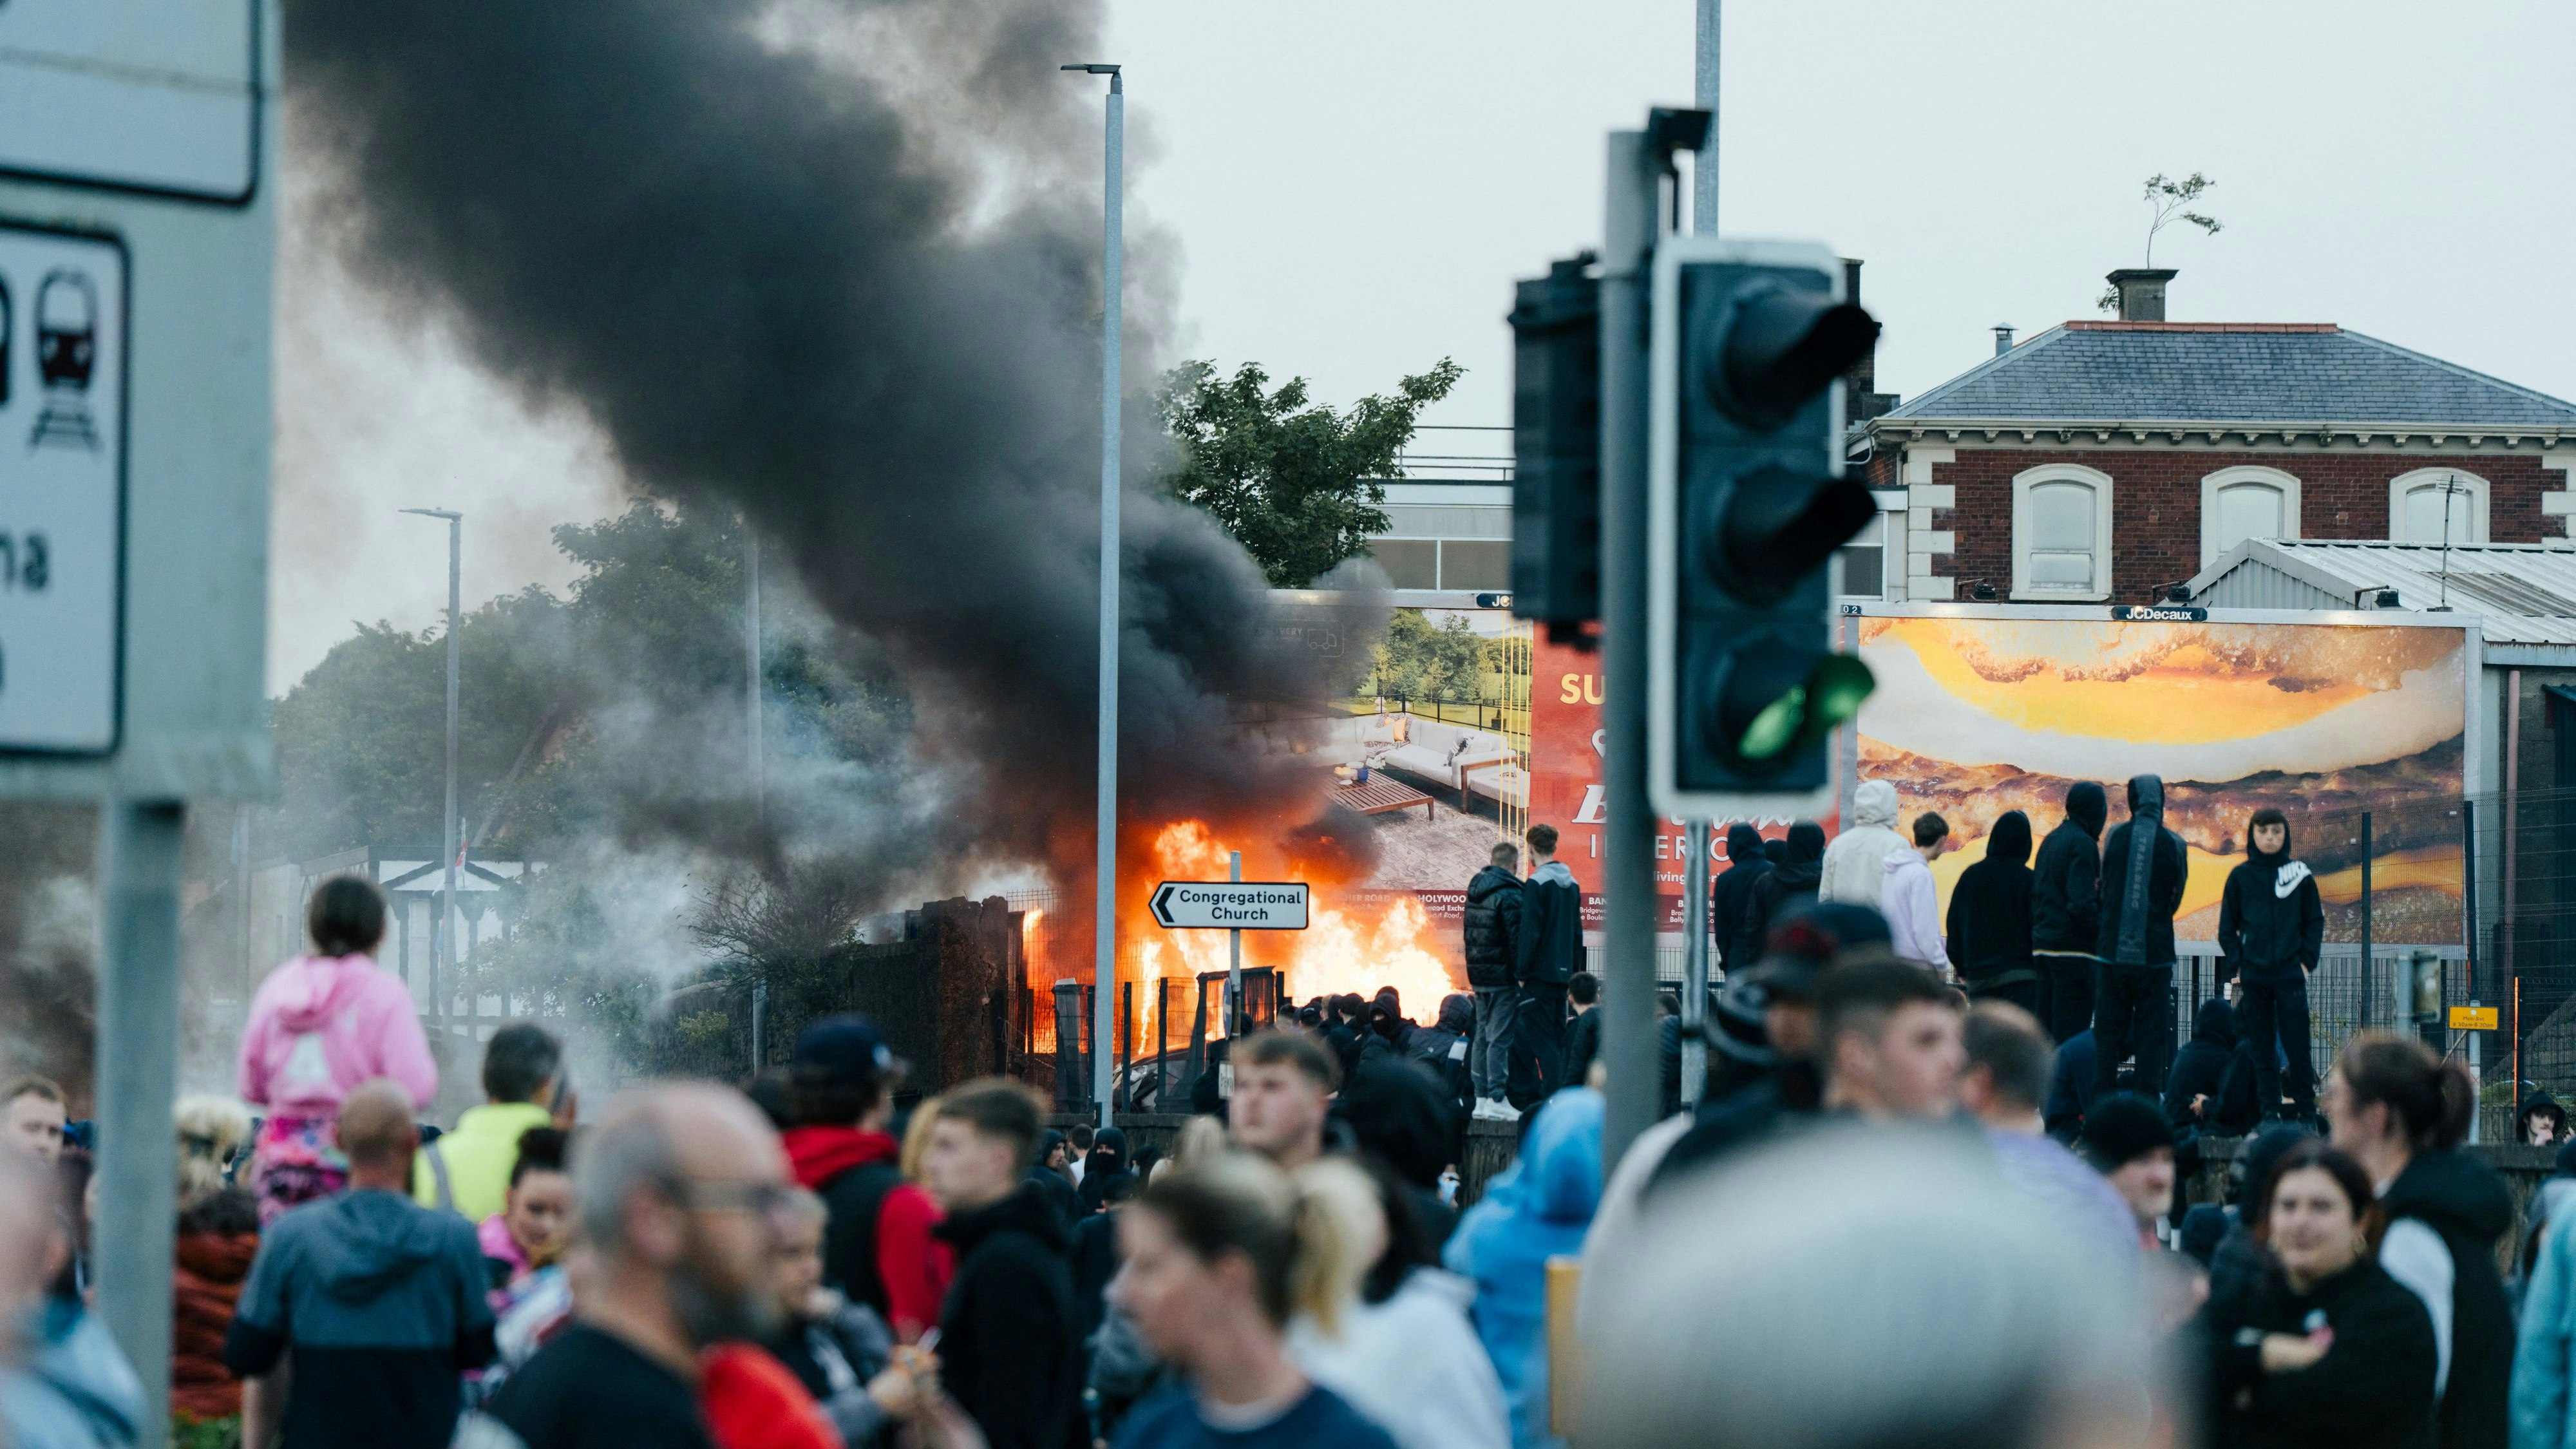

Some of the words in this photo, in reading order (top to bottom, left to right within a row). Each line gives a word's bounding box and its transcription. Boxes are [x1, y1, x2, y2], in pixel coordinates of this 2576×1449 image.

[2126, 608, 2192, 620] JCDecaux
[1560, 673, 1606, 706] SU
[1180, 890, 1302, 905] Congregational
[1418, 895, 1466, 903] HOLYWOO
[1211, 907, 1268, 920] Church
